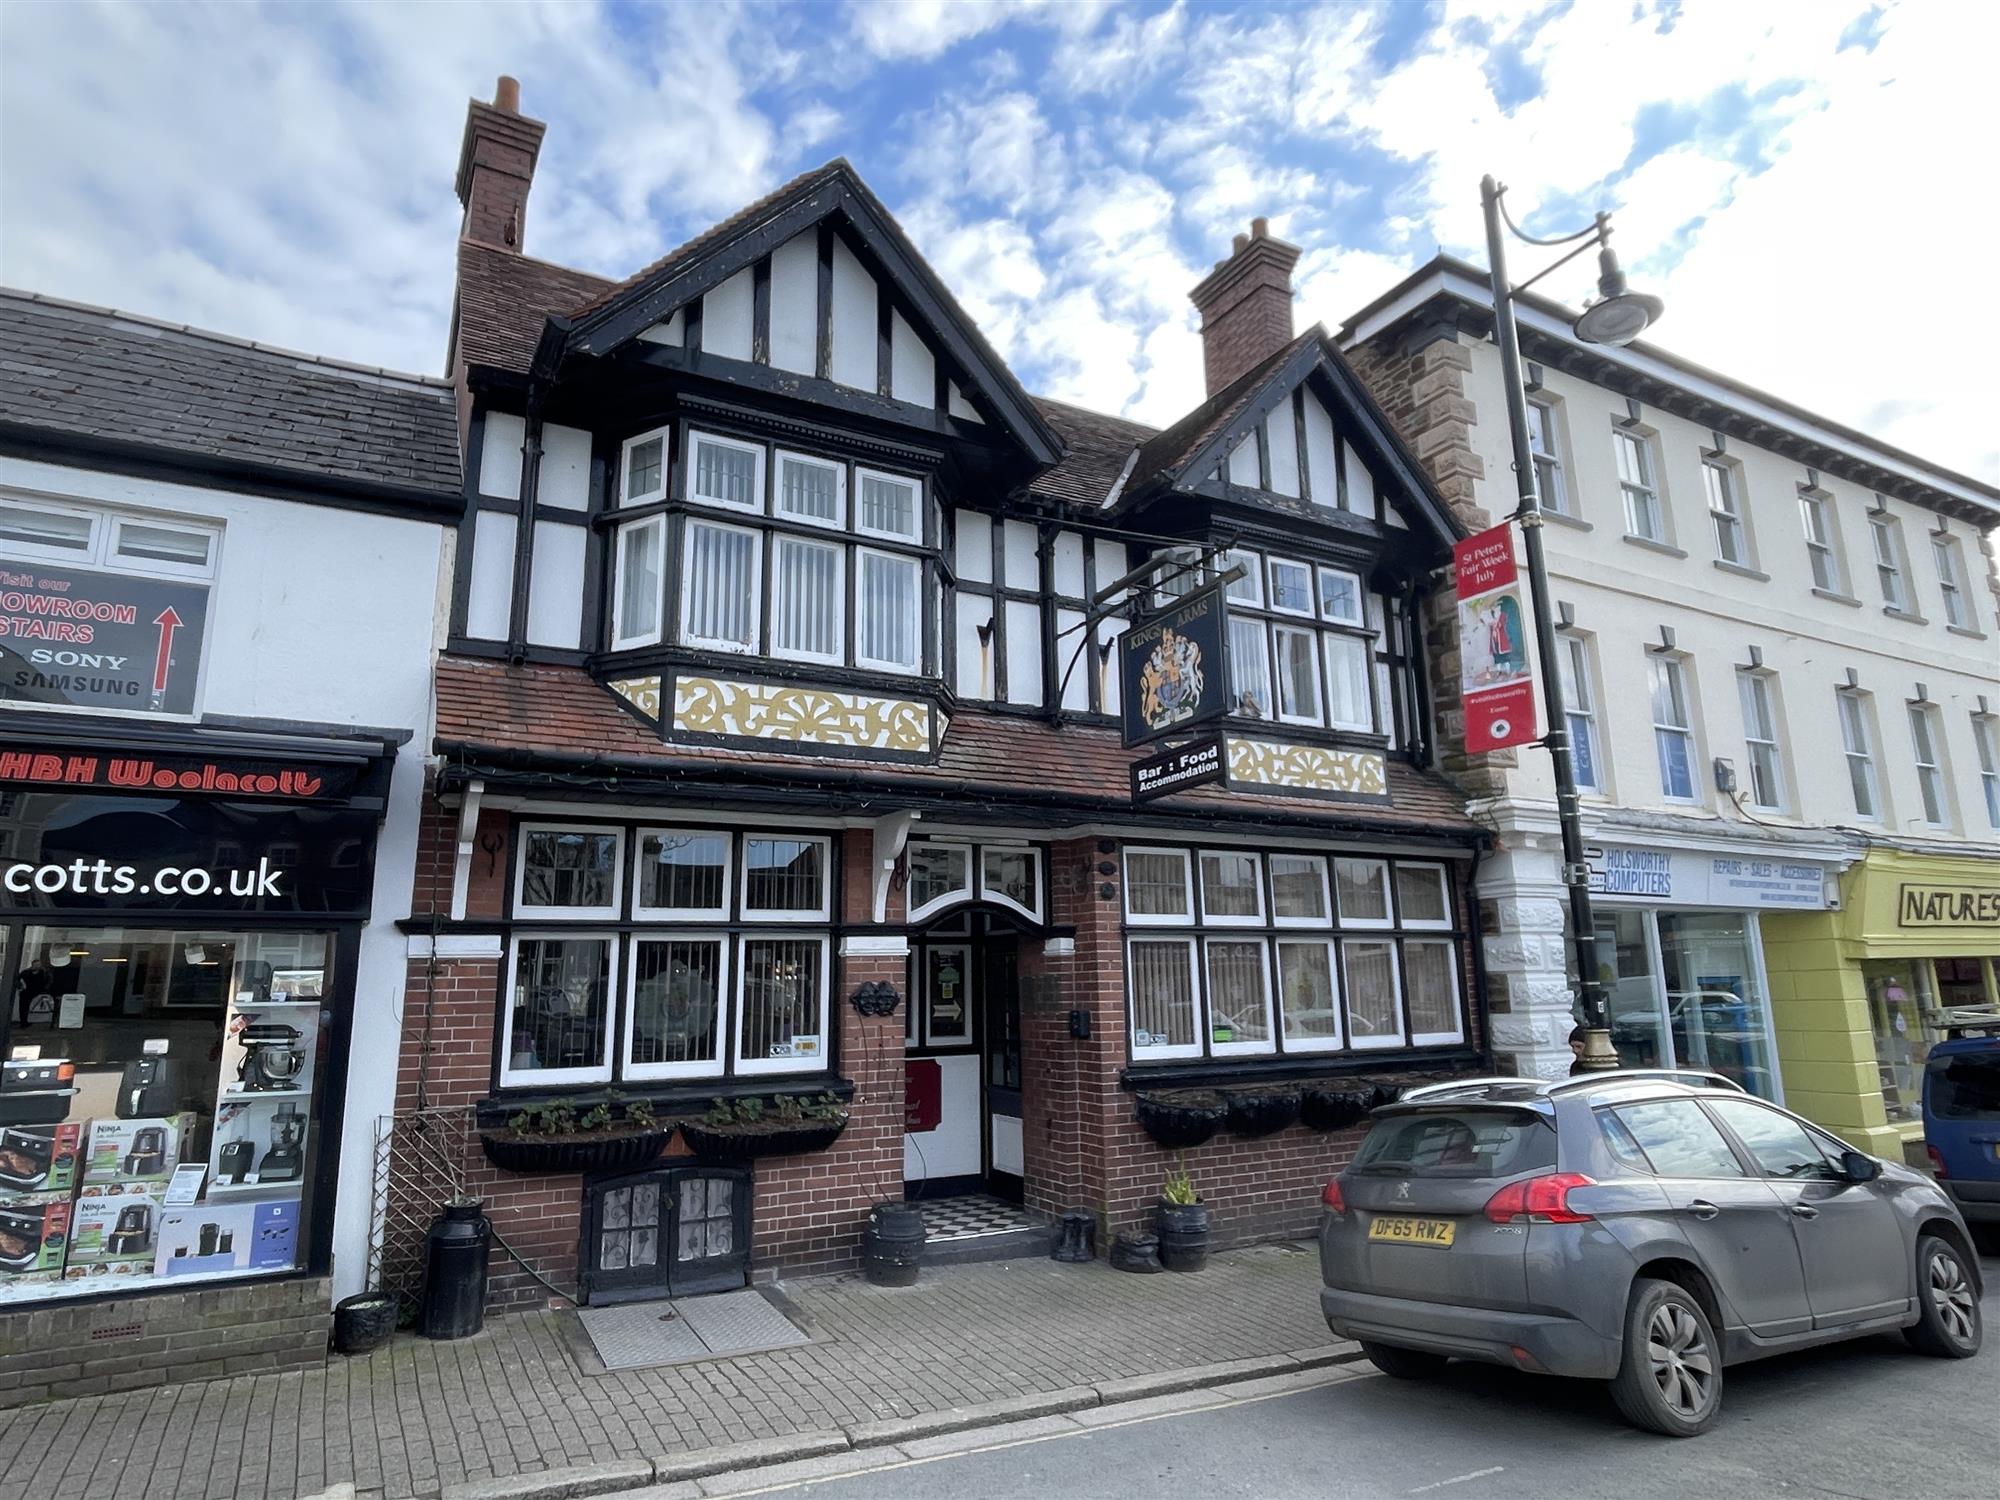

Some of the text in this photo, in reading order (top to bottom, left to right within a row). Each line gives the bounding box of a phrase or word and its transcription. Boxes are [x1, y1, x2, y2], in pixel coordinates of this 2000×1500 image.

[1461, 551, 1509, 577] Fair Week
[1462, 542, 1504, 565] St Peters
[38, 579, 72, 592] our
[1476, 570, 1496, 585] July
[0, 591, 137, 625] OWROOM
[1176, 599, 1208, 628] ARMS
[30, 648, 128, 671] SONY
[14, 671, 140, 696] SAMSUNG
[0, 751, 322, 796] HBH Woolacotts
[1138, 766, 1162, 781] Bar
[1180, 745, 1218, 768] Food
[1139, 761, 1219, 792] Accommodation
[1606, 848, 1672, 872] HOLSWORTHY
[4, 856, 283, 897] cotts.co.uk
[1606, 869, 1672, 894] COMPUTERS
[97, 1125, 122, 1134] NINJA
[81, 1203, 107, 1212] NINJA
[1375, 1219, 1449, 1240] DF65 RWZ
